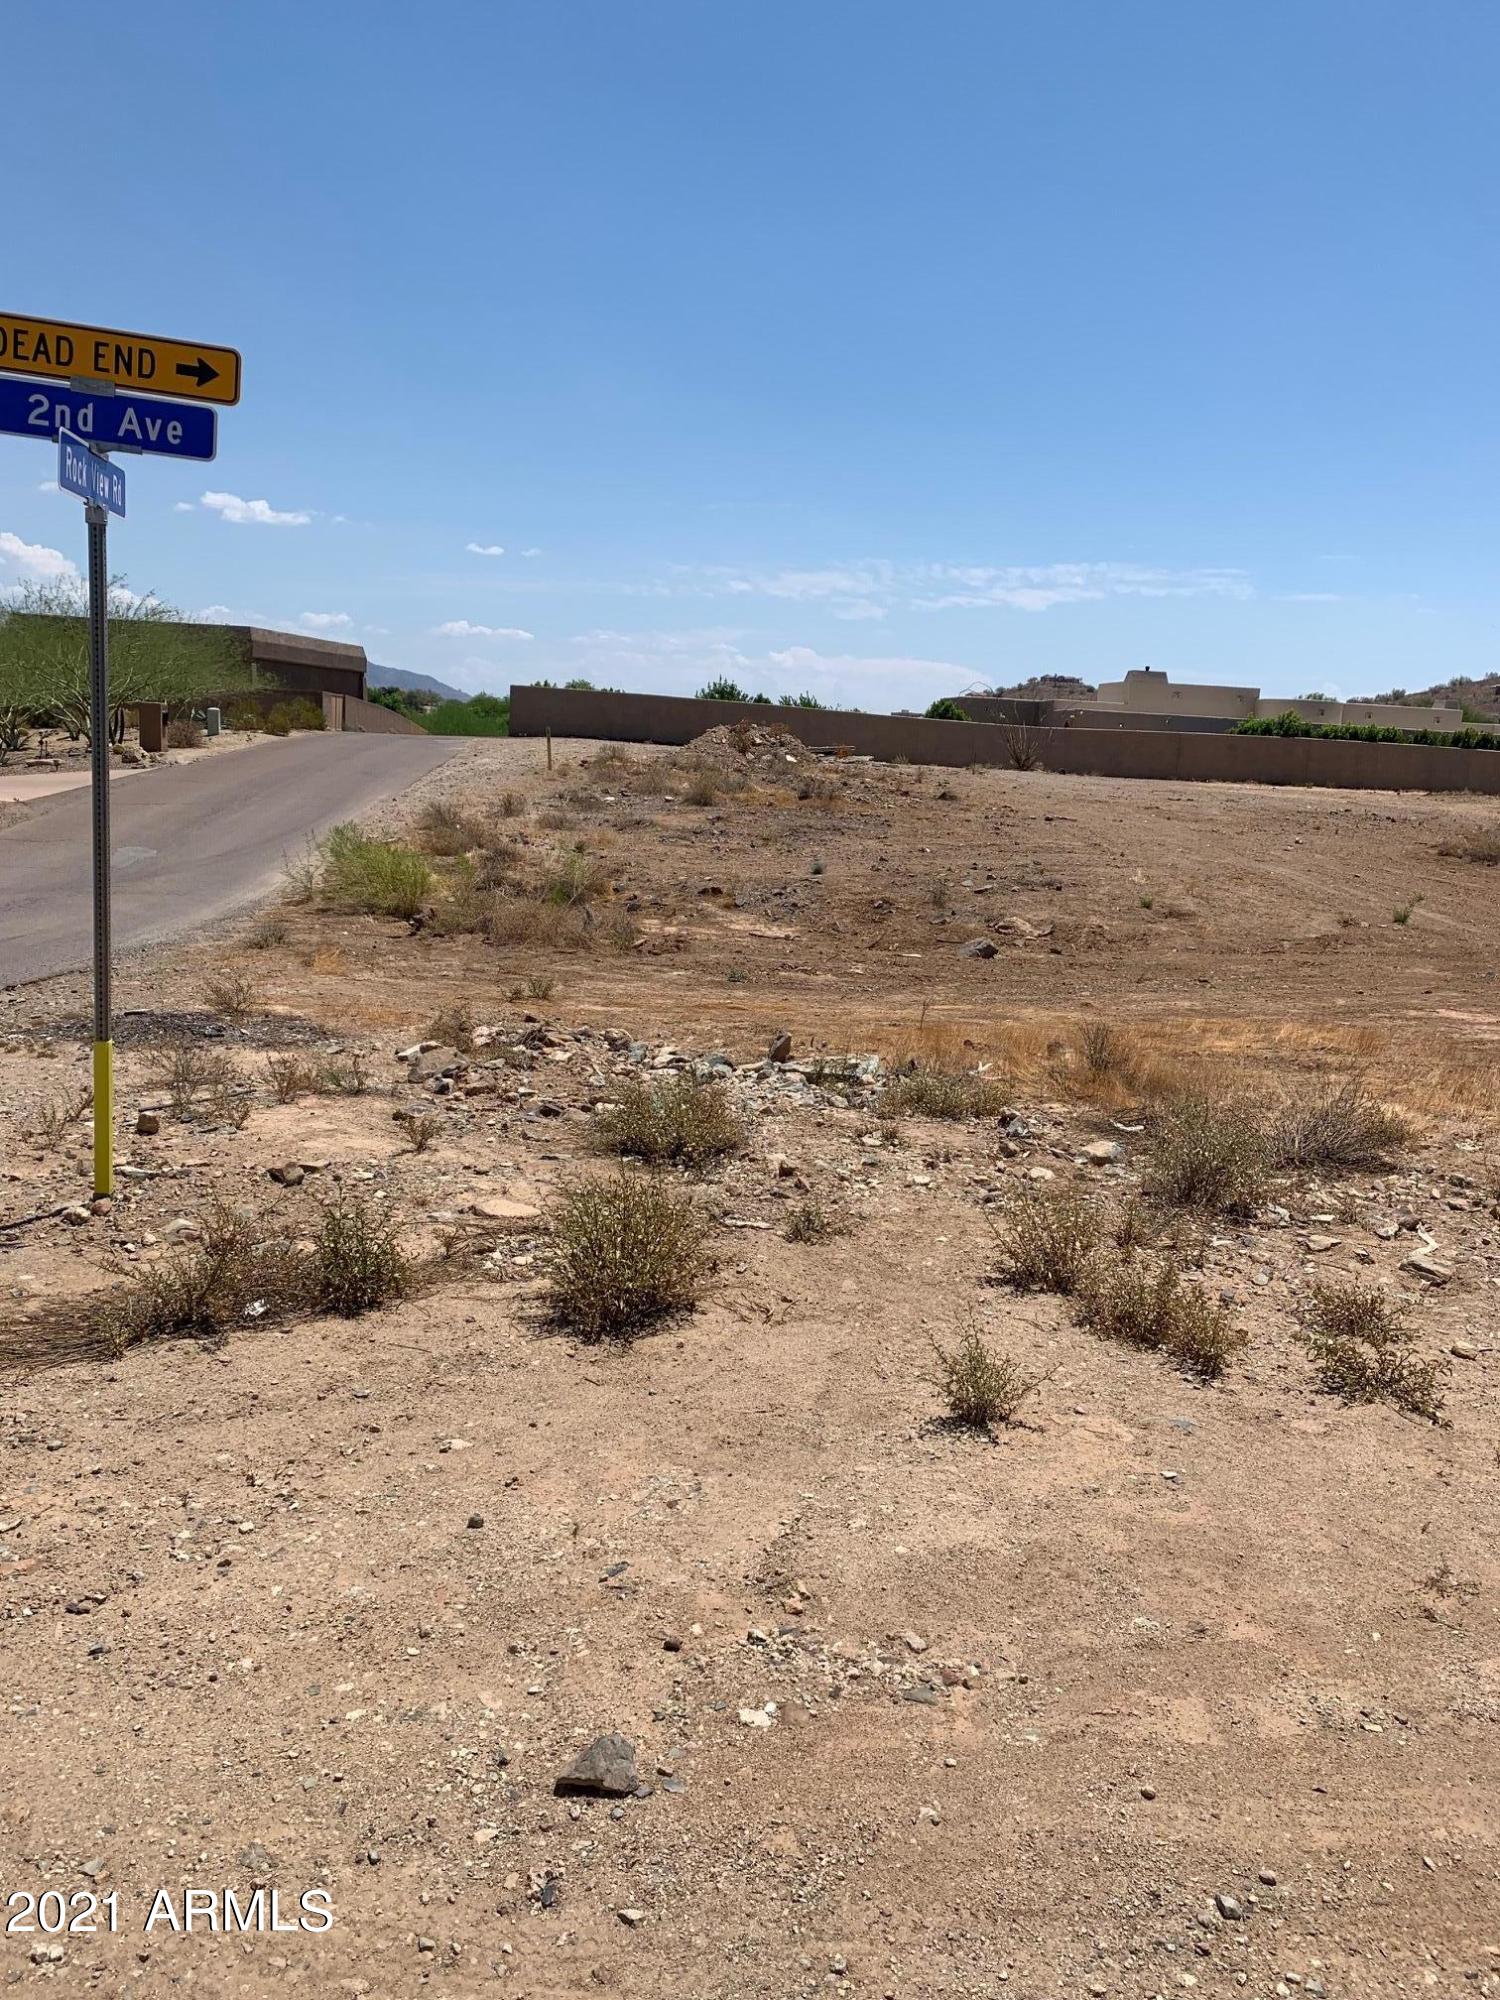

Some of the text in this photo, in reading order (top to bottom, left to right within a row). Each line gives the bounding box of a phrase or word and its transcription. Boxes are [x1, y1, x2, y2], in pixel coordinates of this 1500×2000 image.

[93, 340, 156, 379] END
[27, 393, 184, 445] 2nd Ave
[65, 445, 122, 507] Rock View Rd
